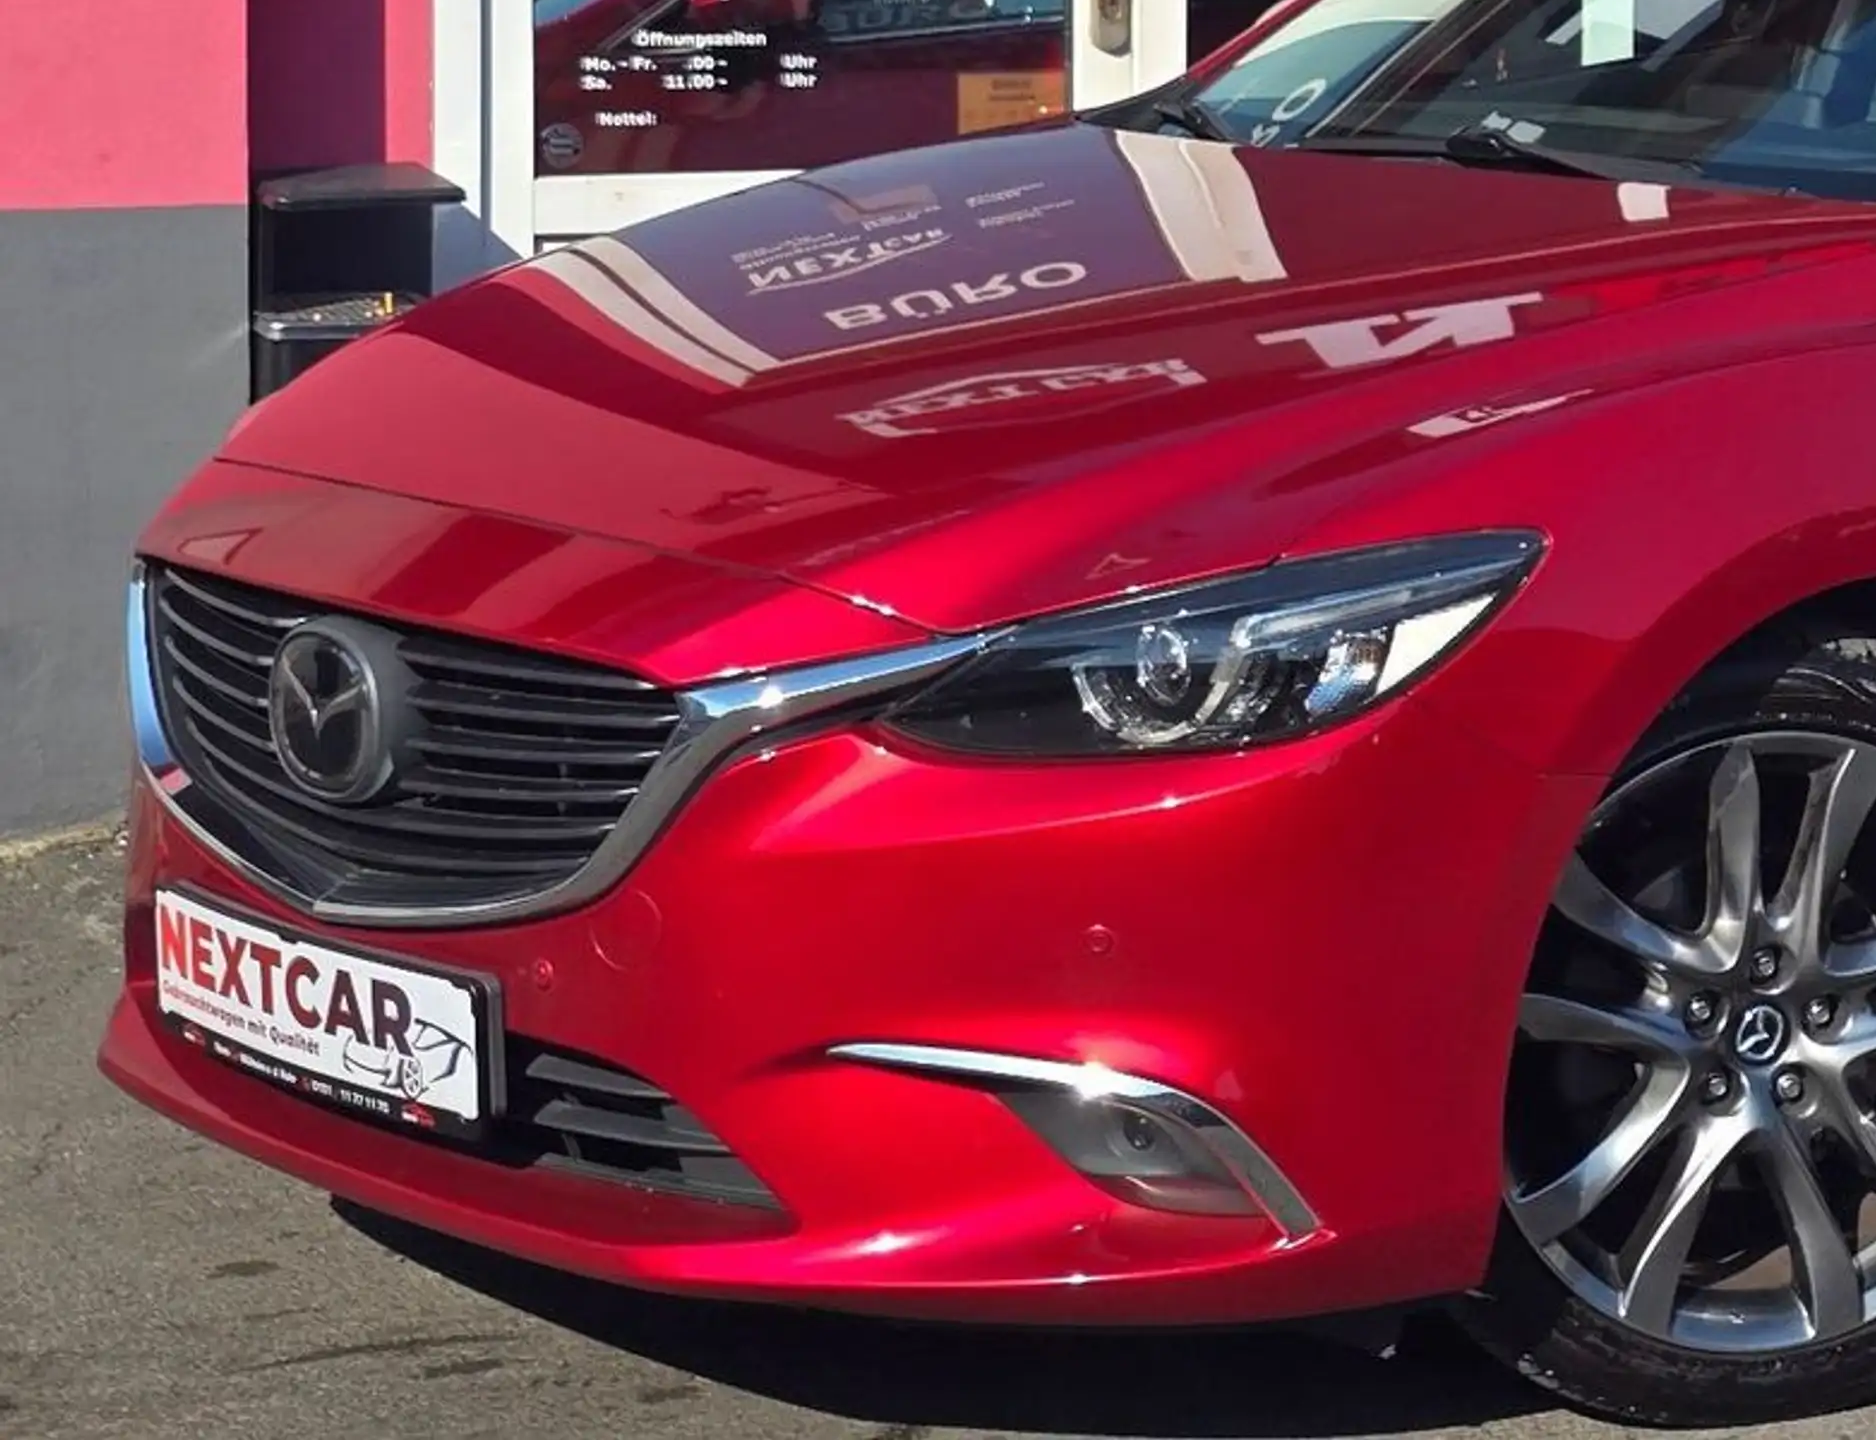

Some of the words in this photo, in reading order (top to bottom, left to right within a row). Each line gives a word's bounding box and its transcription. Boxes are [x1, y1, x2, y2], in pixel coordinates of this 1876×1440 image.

[631, 29, 768, 48] Öffnungszeiten
[778, 55, 818, 70] Uhr
[778, 73, 818, 88] Uhr
